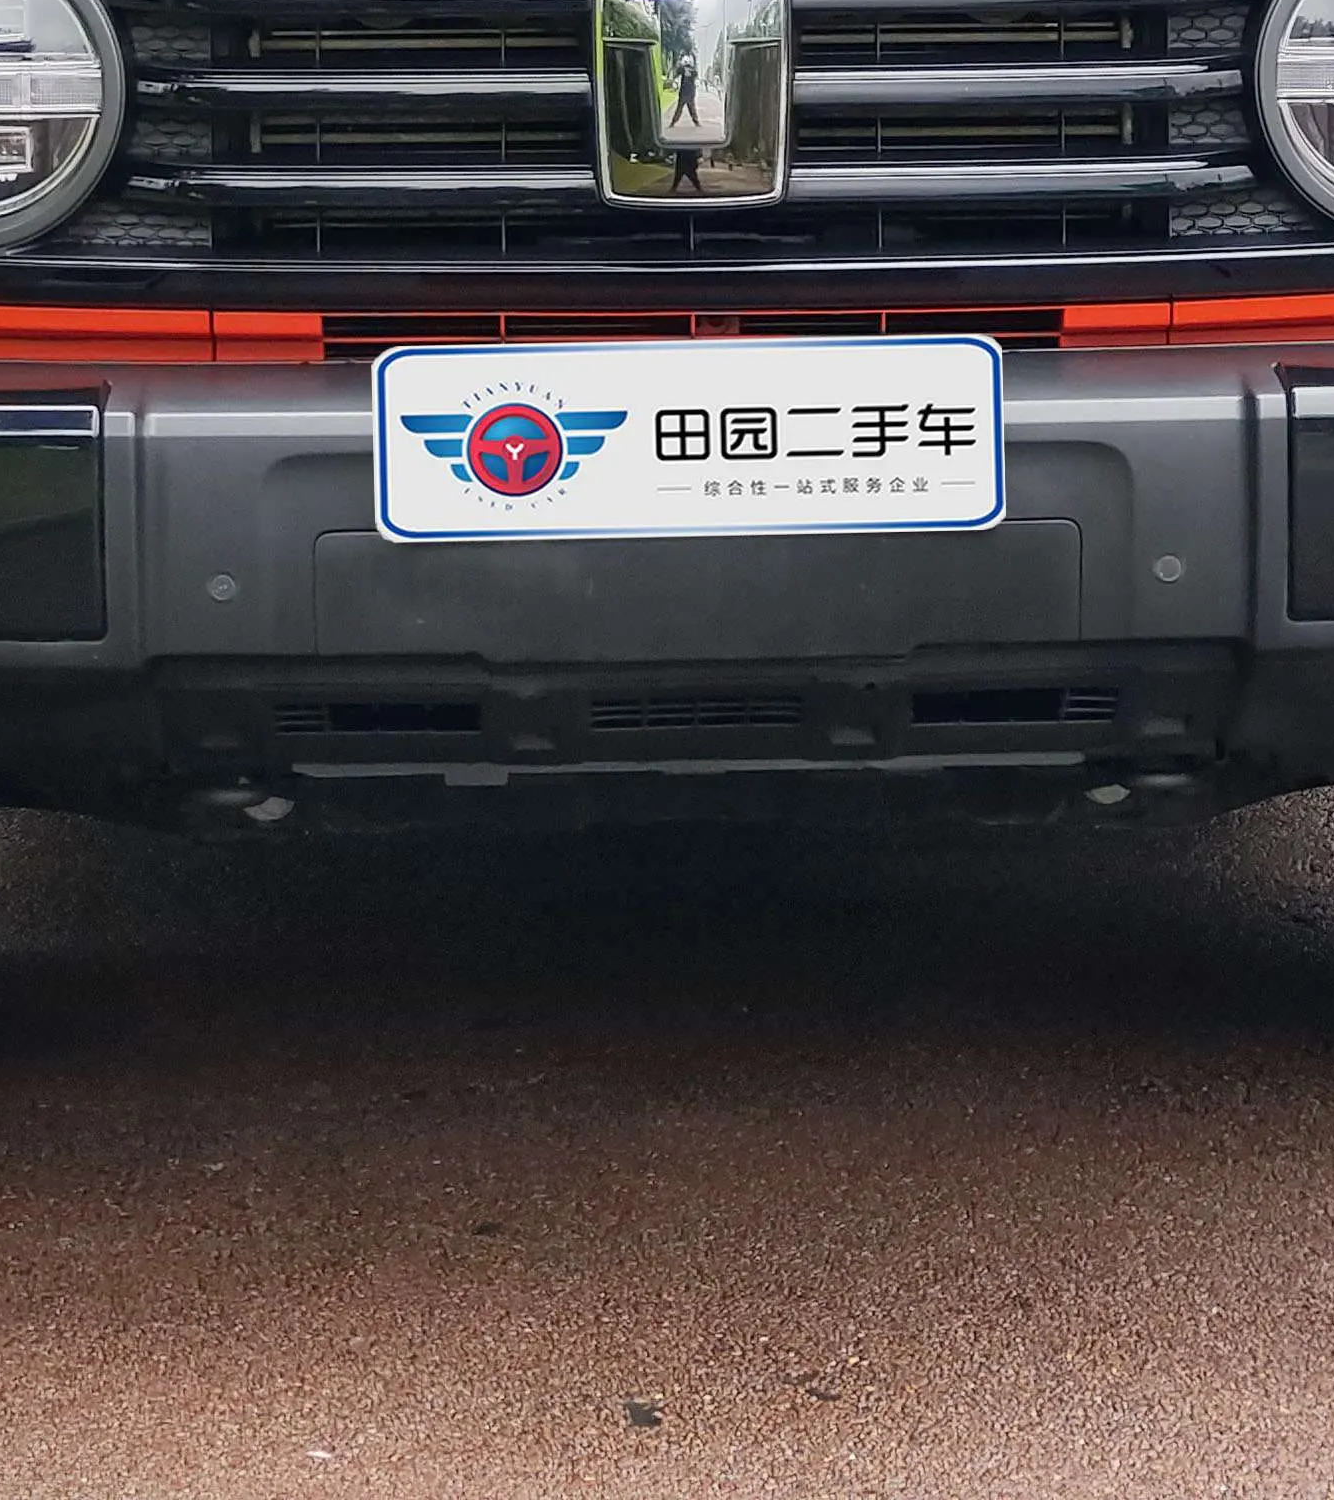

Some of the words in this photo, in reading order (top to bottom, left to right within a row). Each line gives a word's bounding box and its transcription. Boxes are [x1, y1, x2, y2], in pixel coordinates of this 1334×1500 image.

[655, 403, 977, 462] 田园二手车
[703, 476, 930, 497] 综合性一站式服务企业
